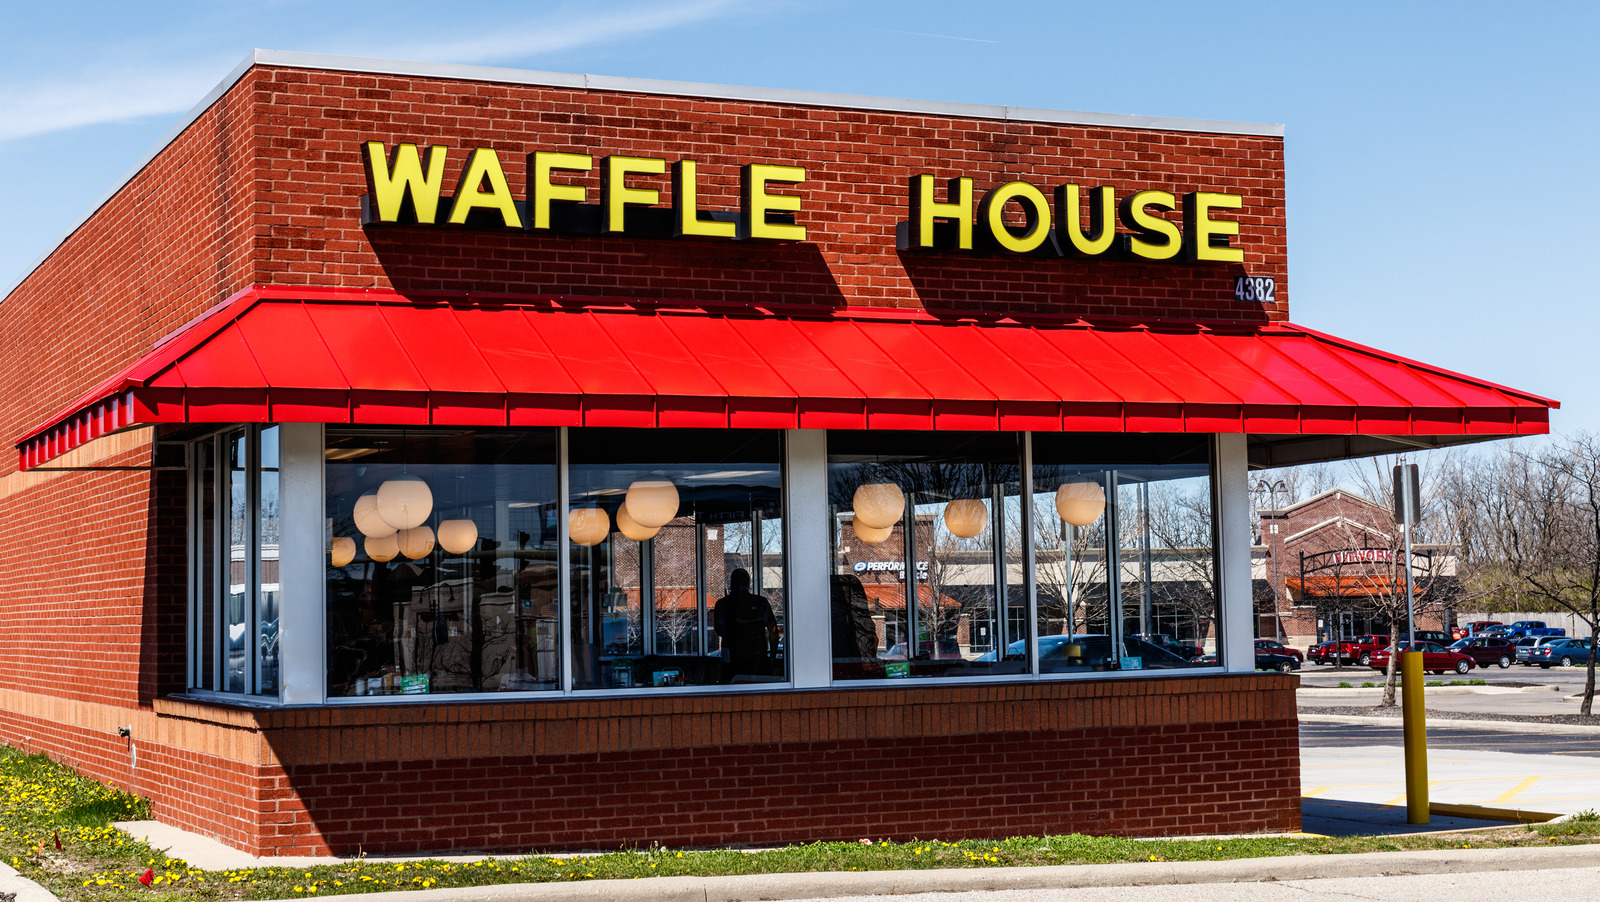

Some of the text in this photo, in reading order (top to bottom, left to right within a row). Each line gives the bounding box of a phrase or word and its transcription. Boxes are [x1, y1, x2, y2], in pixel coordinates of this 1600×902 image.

[368, 142, 1244, 263] WAFFLE HOUSE
[1235, 277, 1275, 301] 4382
